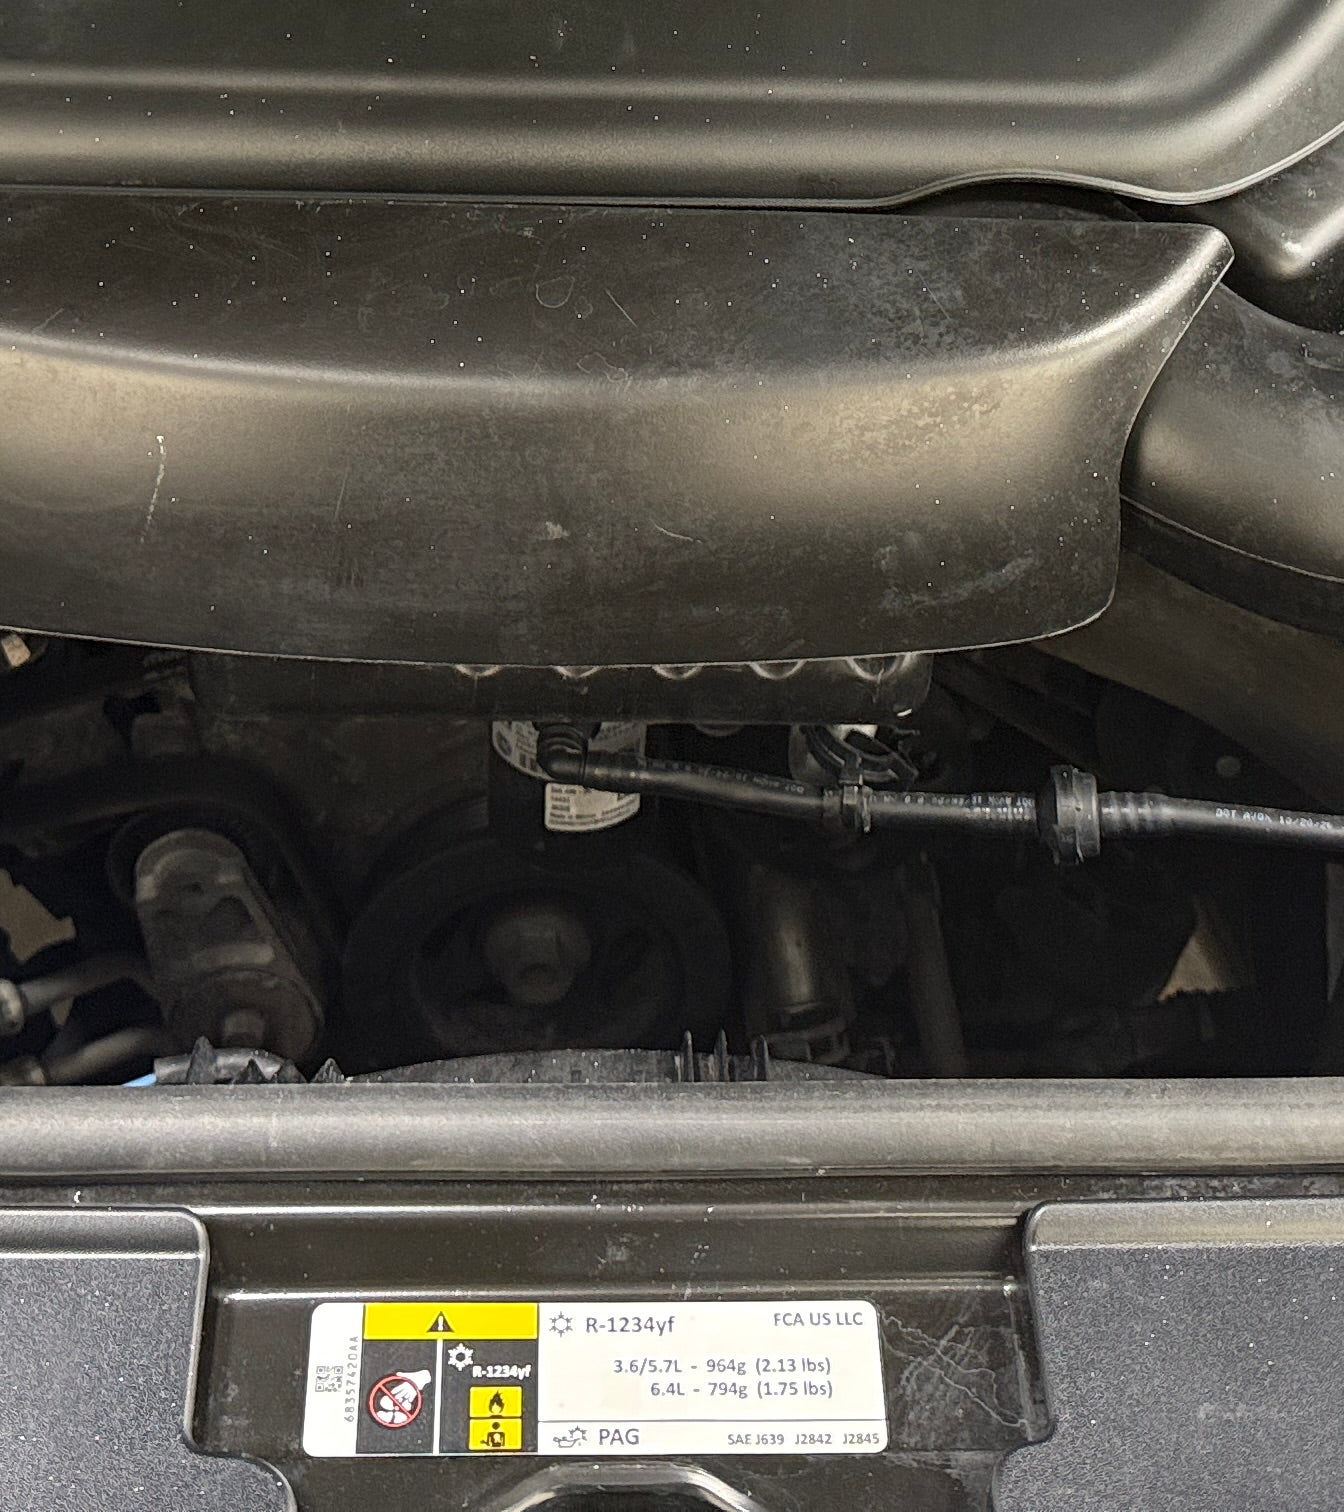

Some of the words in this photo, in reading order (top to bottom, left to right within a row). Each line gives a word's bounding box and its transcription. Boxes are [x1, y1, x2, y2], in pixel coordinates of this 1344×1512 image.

[586, 1316, 676, 1336] R-1234yf
[773, 1312, 803, 1326] FCA
[809, 1312, 832, 1326] US
[836, 1311, 864, 1326] LLC
[472, 1364, 532, 1381] R-1234yf
[613, 1359, 683, 1375] 3.6/5.7L
[706, 1359, 747, 1375] 964g
[755, 1357, 797, 1375] (2.13
[801, 1357, 832, 1375] lbs)
[650, 1382, 685, 1396] 6.4L
[709, 1382, 748, 1399] 794g
[756, 1381, 798, 1399] (1.75
[803, 1381, 834, 1399] lbs)
[598, 1428, 640, 1446] PAG
[727, 1433, 752, 1445] SAE
[755, 1433, 785, 1446] J639
[794, 1433, 833, 1445] J2842
[842, 1433, 880, 1445] J2845
